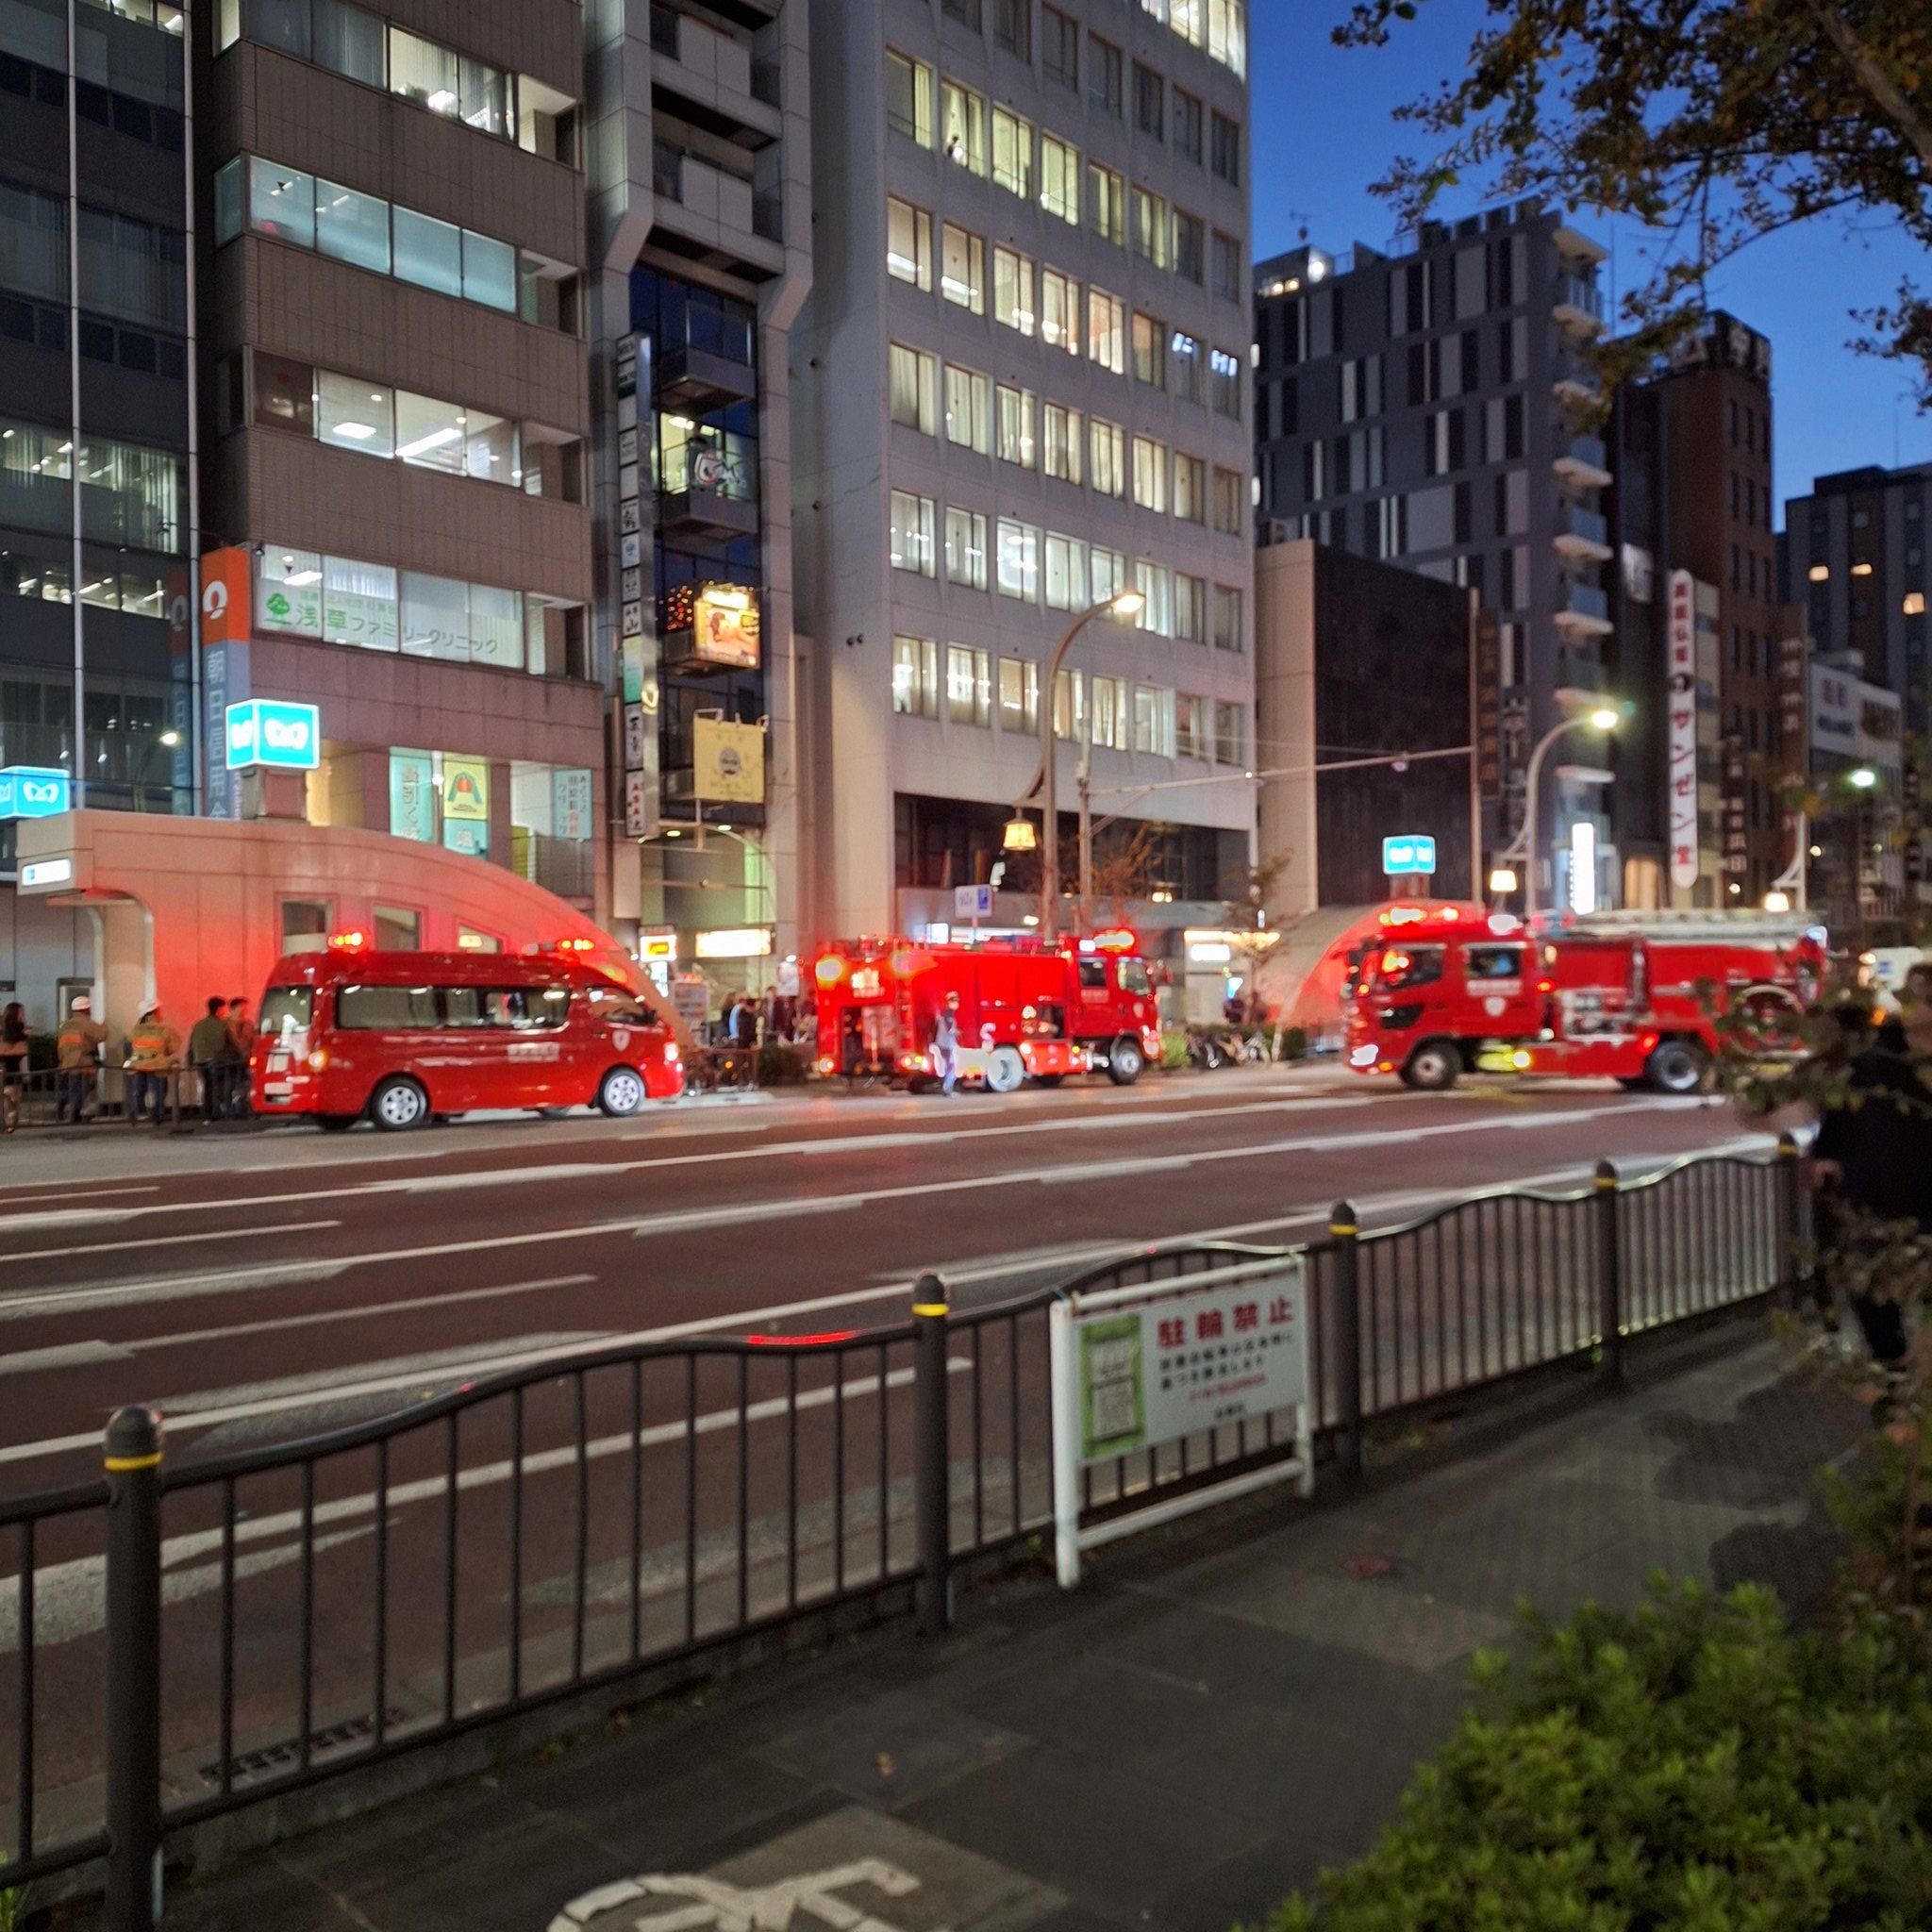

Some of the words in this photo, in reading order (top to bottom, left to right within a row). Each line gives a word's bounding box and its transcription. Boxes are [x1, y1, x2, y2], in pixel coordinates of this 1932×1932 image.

[295, 603, 498, 654] 浅草ファミリークリニック
[1158, 1295, 1293, 1349] 駐輪禁止
